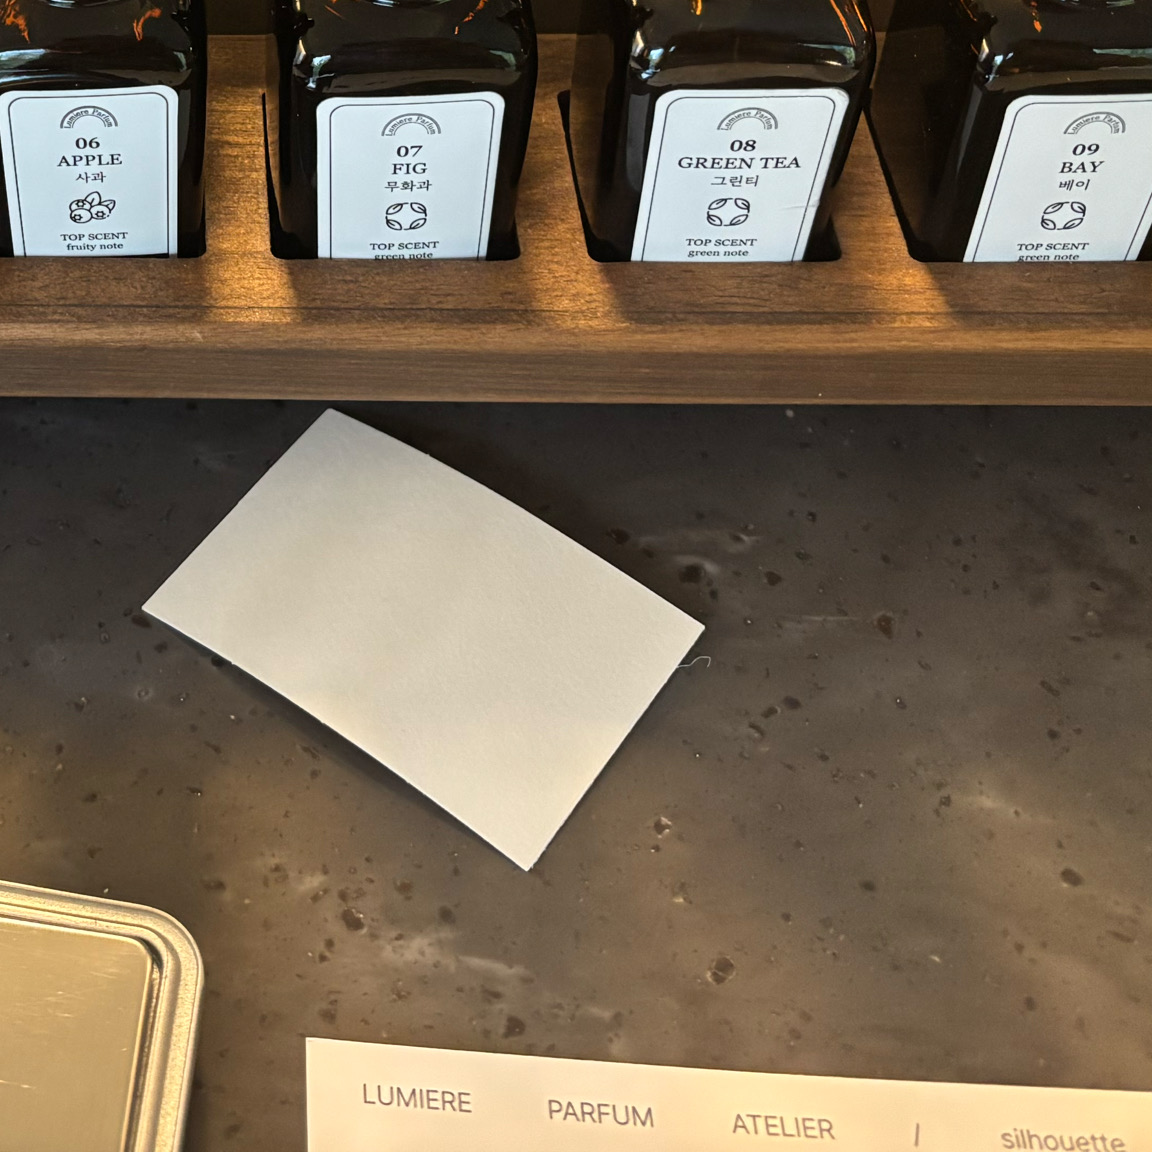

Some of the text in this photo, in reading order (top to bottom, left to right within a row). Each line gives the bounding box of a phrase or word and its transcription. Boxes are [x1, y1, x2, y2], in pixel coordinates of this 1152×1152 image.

[75, 137, 100, 149] 06
[730, 140, 756, 152] 08
[397, 146, 423, 157] 07
[1072, 144, 1099, 156] 09
[57, 154, 122, 167] APPLE
[678, 157, 801, 169] GREEN TEA
[392, 163, 428, 174] FIG
[1059, 161, 1104, 173] BAY
[76, 172, 106, 183] 사과
[711, 175, 759, 187] 그린티
[385, 180, 432, 192] 무화과
[1059, 179, 1090, 191] 베이
[60, 232, 128, 241] TOP SCENT
[67, 243, 96, 251] fruity
[688, 250, 720, 258] green
[362, 1083, 1125, 1152] LUMIERE PARFUM ATELIER silhouette
